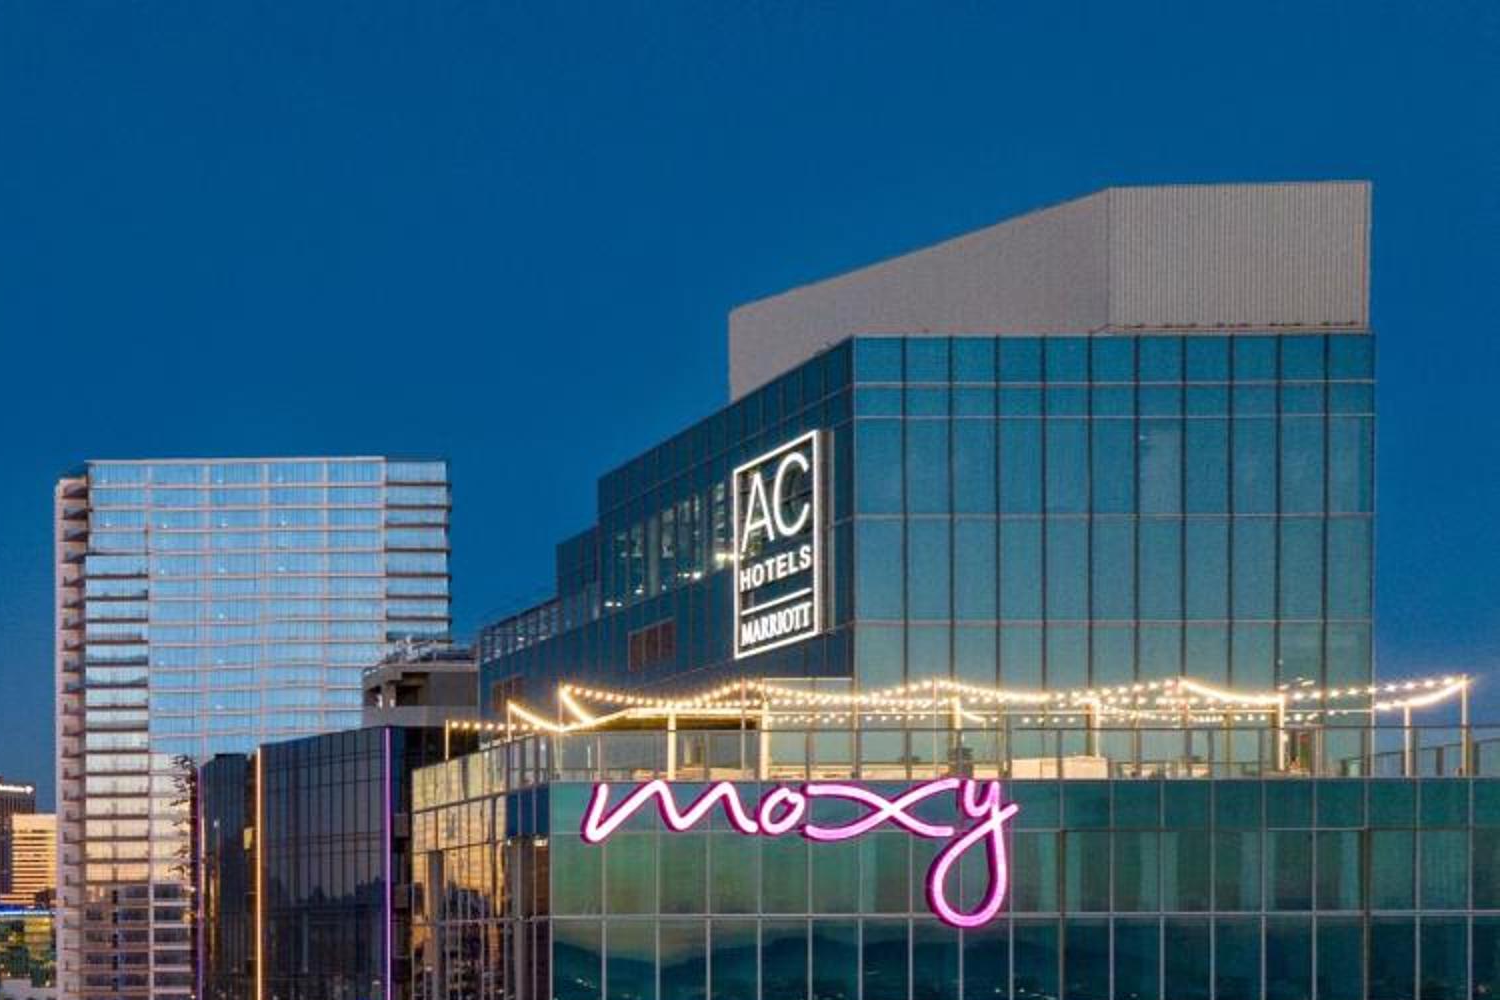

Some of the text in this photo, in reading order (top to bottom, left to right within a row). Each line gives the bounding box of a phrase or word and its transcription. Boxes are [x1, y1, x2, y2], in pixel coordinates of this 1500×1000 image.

[741, 451, 810, 553] AC
[740, 545, 812, 593] HOTELS
[740, 602, 813, 647] MARRIOTT
[583, 777, 1019, 928] moxy
